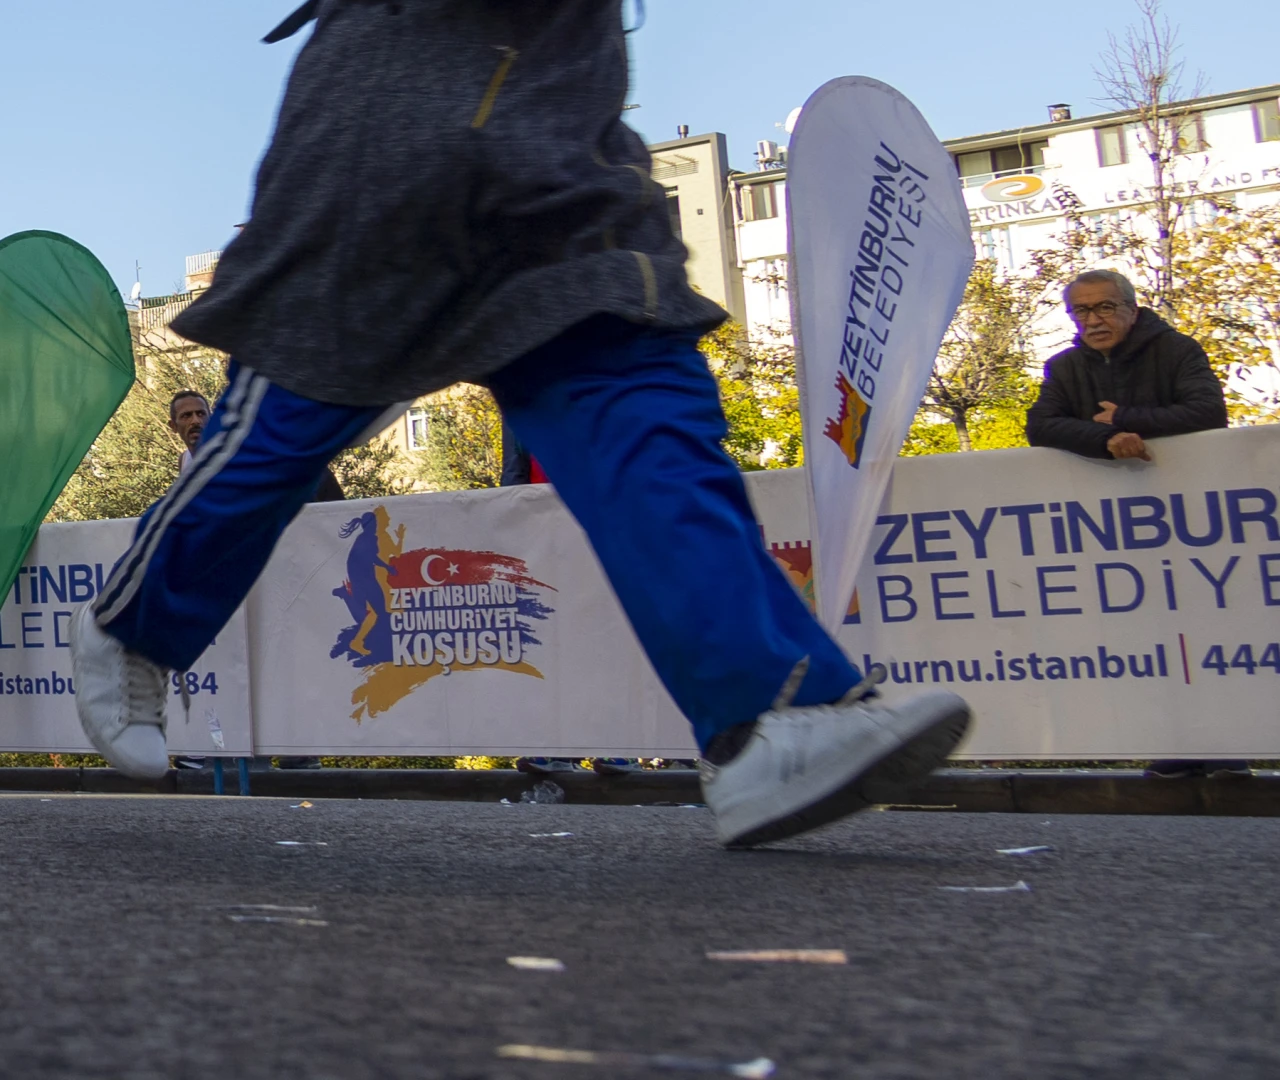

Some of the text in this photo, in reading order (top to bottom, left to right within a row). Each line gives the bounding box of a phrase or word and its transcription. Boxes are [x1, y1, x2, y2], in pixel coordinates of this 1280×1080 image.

[1211, 173, 1252, 188] AND
[392, 630, 522, 675] KOŞUSU
[852, 644, 1168, 684] burnu.istanbul
